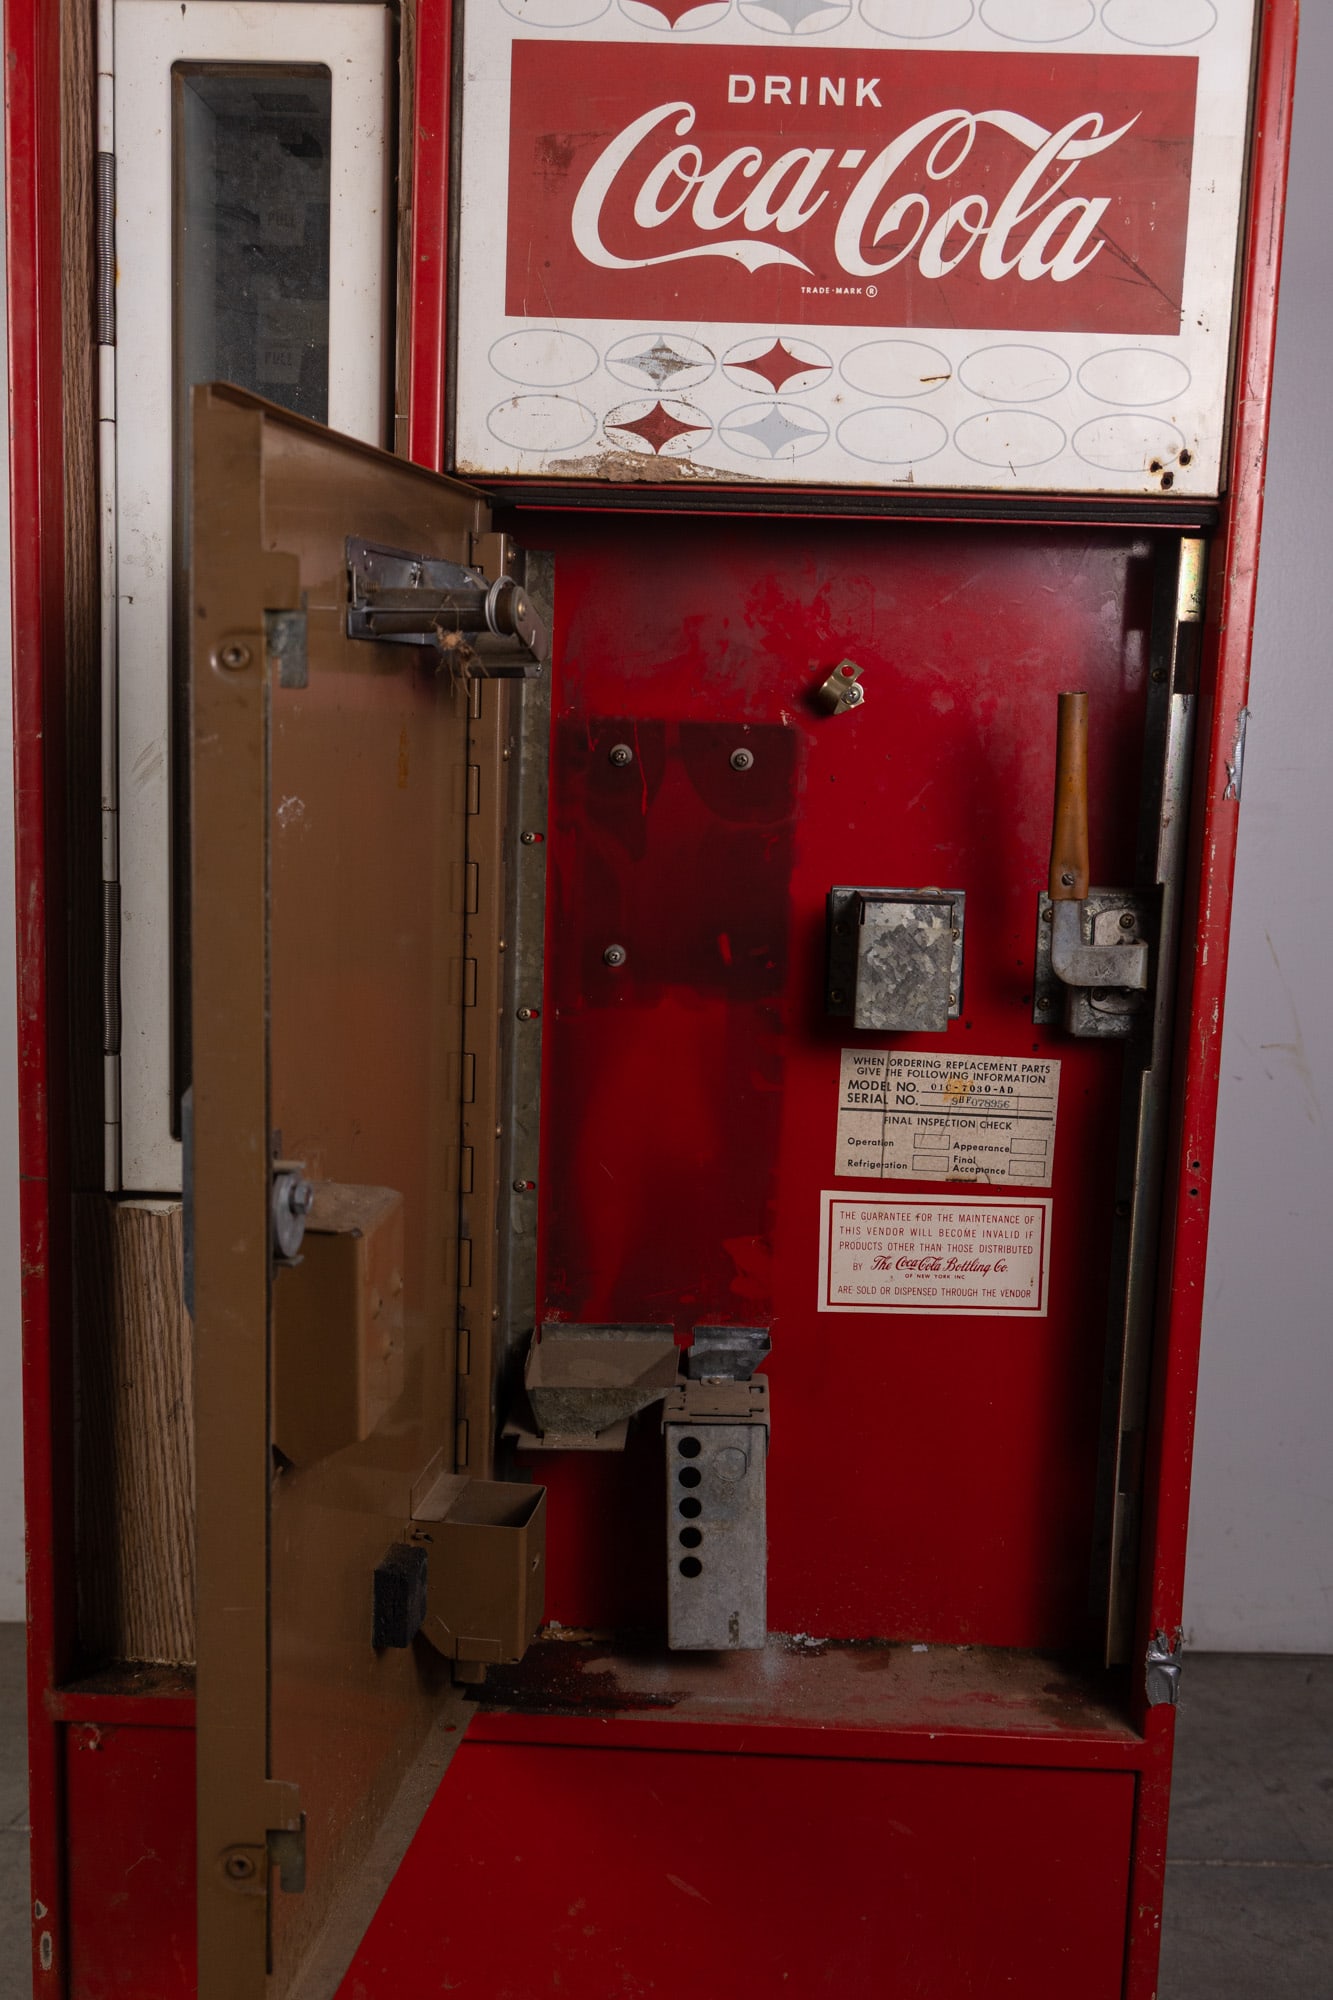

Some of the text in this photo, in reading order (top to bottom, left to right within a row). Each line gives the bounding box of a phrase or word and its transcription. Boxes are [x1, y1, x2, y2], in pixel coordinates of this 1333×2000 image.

[728, 74, 882, 107] DRINK
[571, 101, 1142, 282] Coca-Cola
[853, 1057, 1050, 1074] WHEN ORDERING REPLACEMENT PARTS
[857, 1067, 1046, 1083] GIVE THE FOLLOWING INFORMATION
[848, 1080, 892, 1091] MODEL
[897, 1082, 919, 1093] NO.
[847, 1093, 888, 1104] SERIAL
[896, 1095, 919, 1106] NO.
[884, 1117, 1012, 1130] FINAL INSPECTION CHECK
[847, 1138, 894, 1147] Operation
[953, 1142, 1010, 1152] Appearance
[847, 1159, 908, 1170] Refrigeration
[953, 1156, 976, 1164] Final
[953, 1165, 1006, 1175] Acceptance
[840, 1211, 856, 1220] THE
[861, 1212, 911, 1221] GUARANTEE
[938, 1214, 953, 1222] THE
[958, 1214, 1020, 1224] MAINTENANCE
[1025, 1216, 1035, 1224] OF
[840, 1226, 1034, 1239] THIS VENDOR WILL BECOME INVALID IF
[839, 1242, 1033, 1254] PRODUCTS OTHER THAN THOSE DISTRIBUTED
[853, 1255, 1008, 1277] BY The Coca-Cola Bottling Co.
[838, 1285, 1031, 1298] ARE SOLD OR DISPENSED THROUGH THE VENDOR
